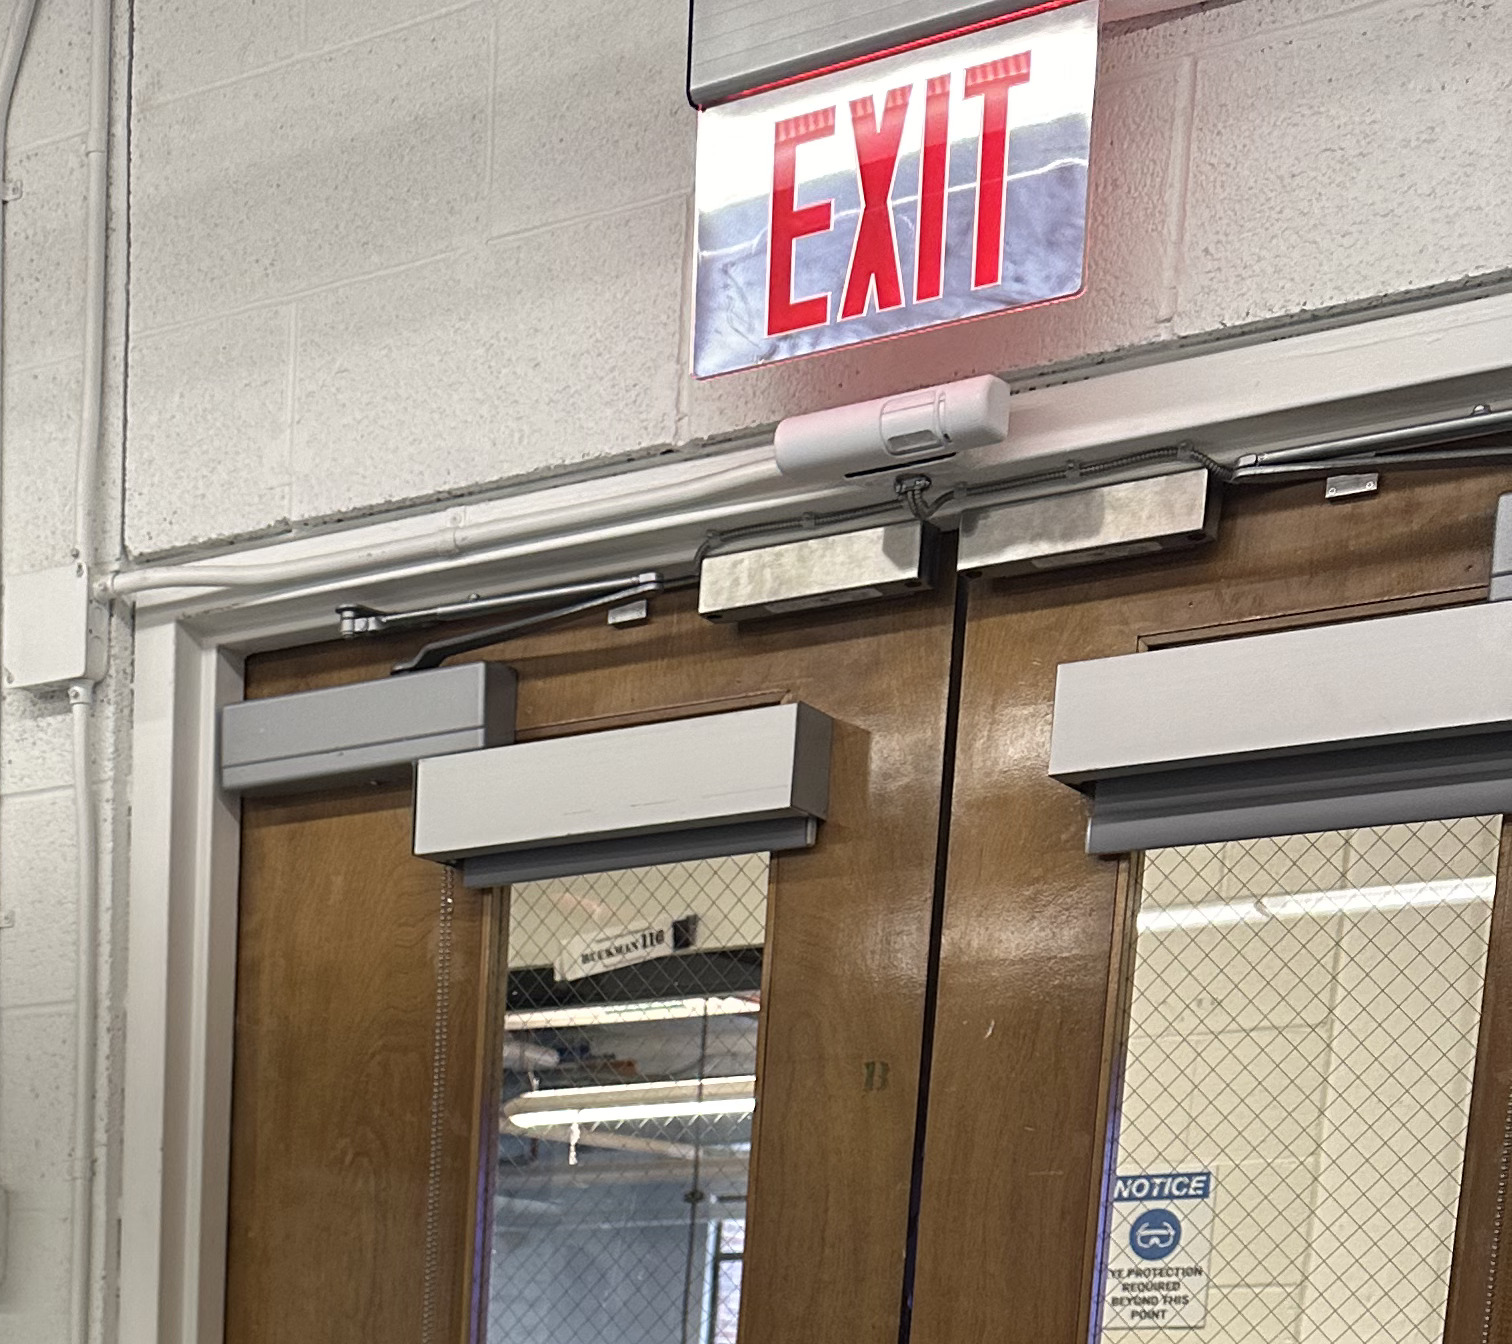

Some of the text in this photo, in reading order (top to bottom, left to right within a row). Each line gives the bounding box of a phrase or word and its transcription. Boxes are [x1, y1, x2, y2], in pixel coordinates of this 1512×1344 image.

[766, 49, 1032, 339] EXIT
[1113, 1175, 1207, 1199] NOTICE
[1127, 1265, 1204, 1279] PROTECTION
